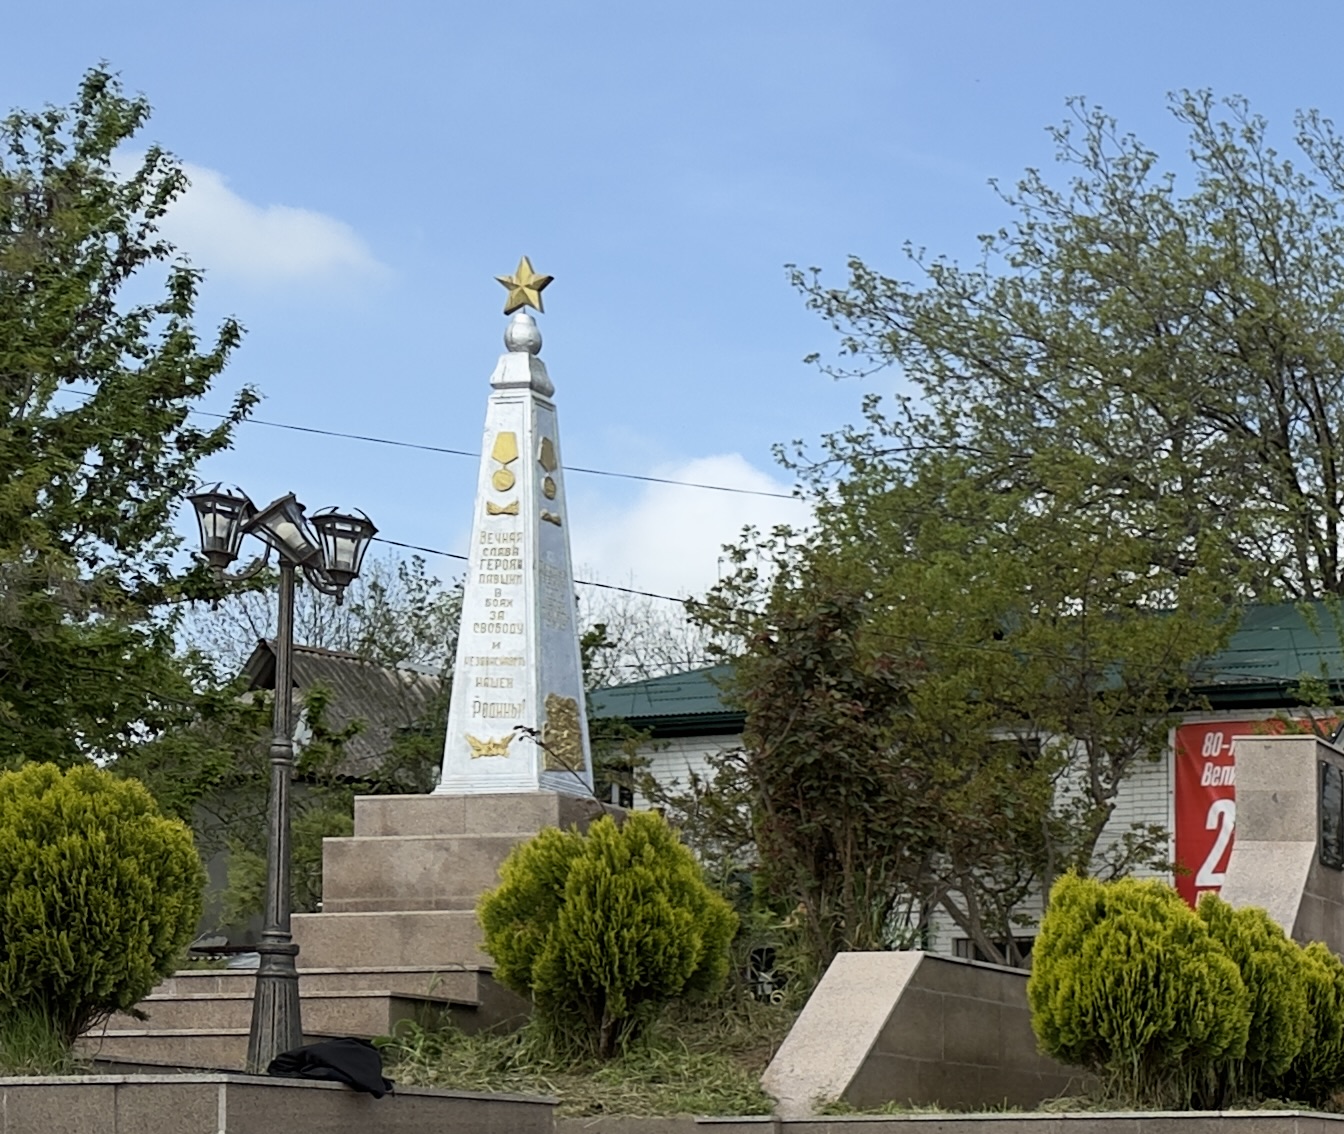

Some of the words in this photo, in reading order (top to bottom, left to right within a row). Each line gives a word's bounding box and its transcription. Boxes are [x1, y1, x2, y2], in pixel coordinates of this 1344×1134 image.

[479, 530, 523, 546] ВЕЧНАЯ
[482, 547, 520, 557] СЛАВА
[494, 588, 502, 598] В
[485, 598, 513, 608] БОЯХ
[489, 610, 505, 621] ЗА
[473, 622, 524, 635] СВОБОДУ
[492, 641, 501, 650] И
